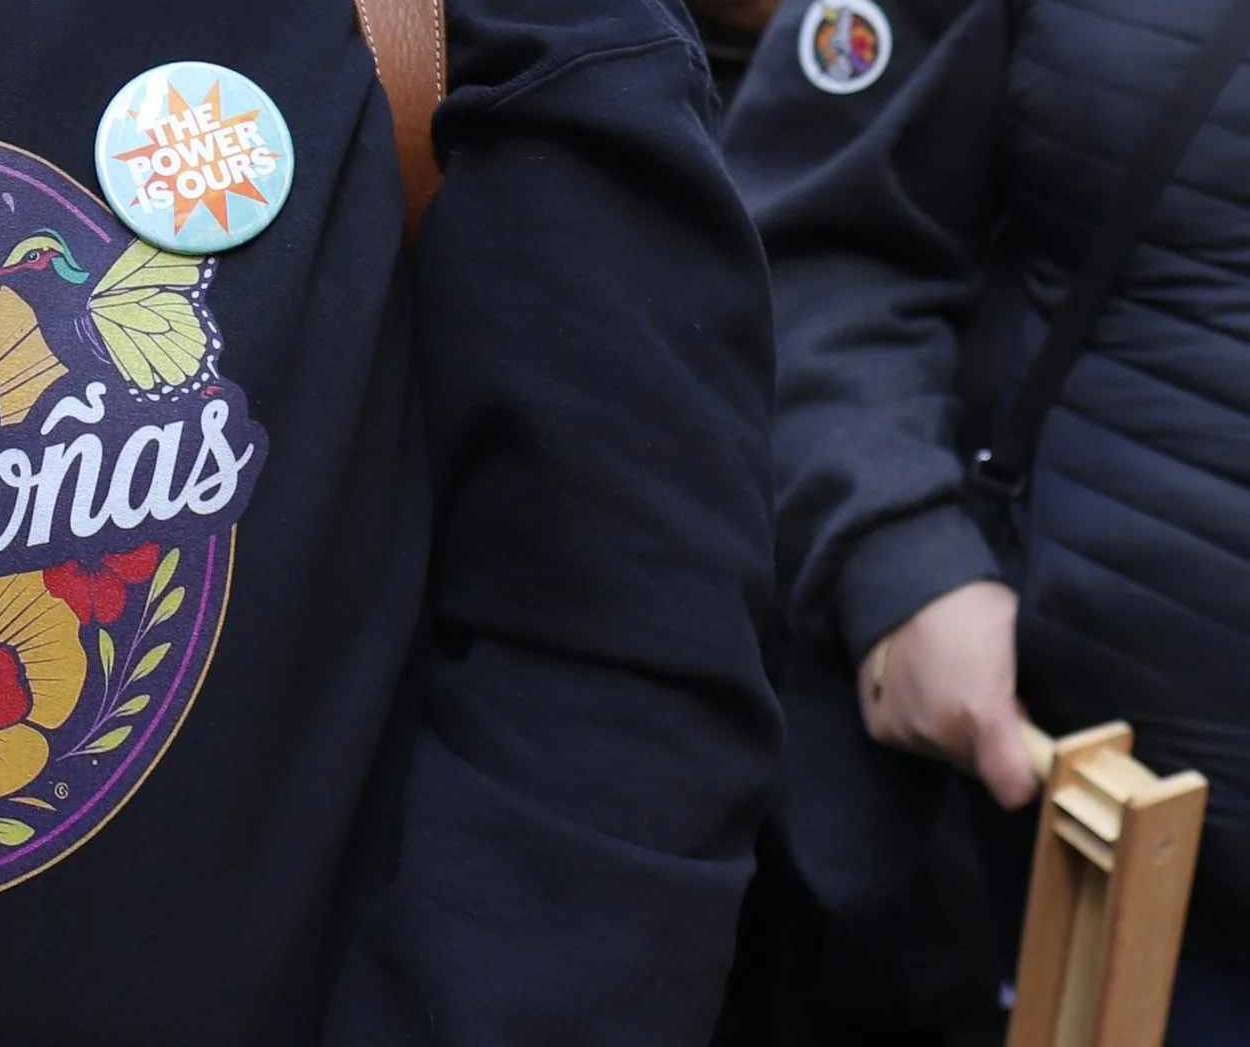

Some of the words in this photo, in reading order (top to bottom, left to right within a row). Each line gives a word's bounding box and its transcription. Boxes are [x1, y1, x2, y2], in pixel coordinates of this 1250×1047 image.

[126, 120, 266, 187] POWER
[151, 102, 221, 148] THE
[135, 180, 175, 214] IS
[175, 146, 277, 200] OURS
